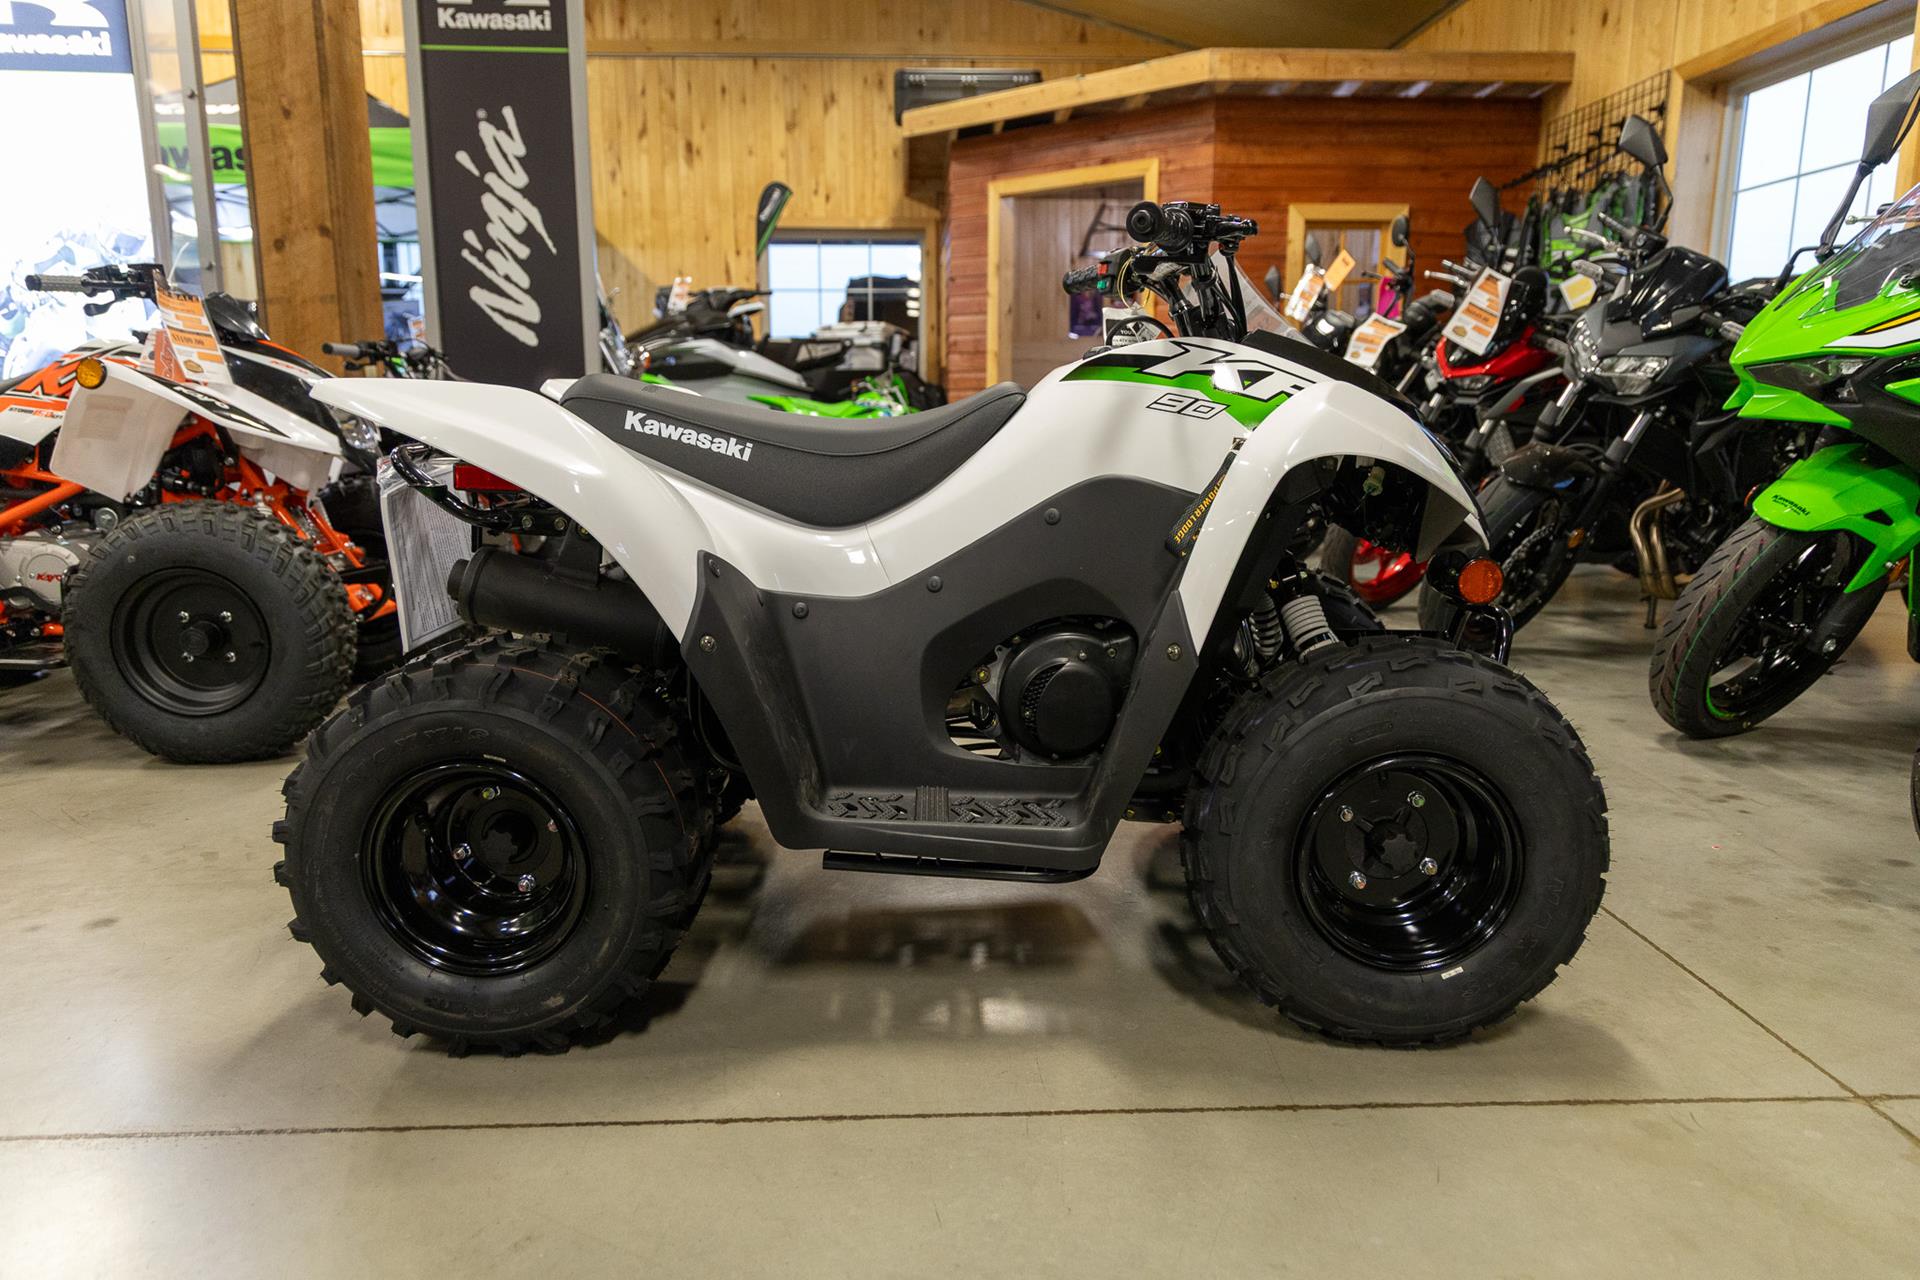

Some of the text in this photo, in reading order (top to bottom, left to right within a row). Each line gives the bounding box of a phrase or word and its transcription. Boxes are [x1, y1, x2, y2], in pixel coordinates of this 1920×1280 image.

[436, 7, 552, 31] Kawasaki
[455, 105, 557, 347] Ninja
[1145, 392, 1231, 420] 90
[624, 409, 753, 462] Kawasaki
[1771, 494, 1811, 516] Kawasaki
